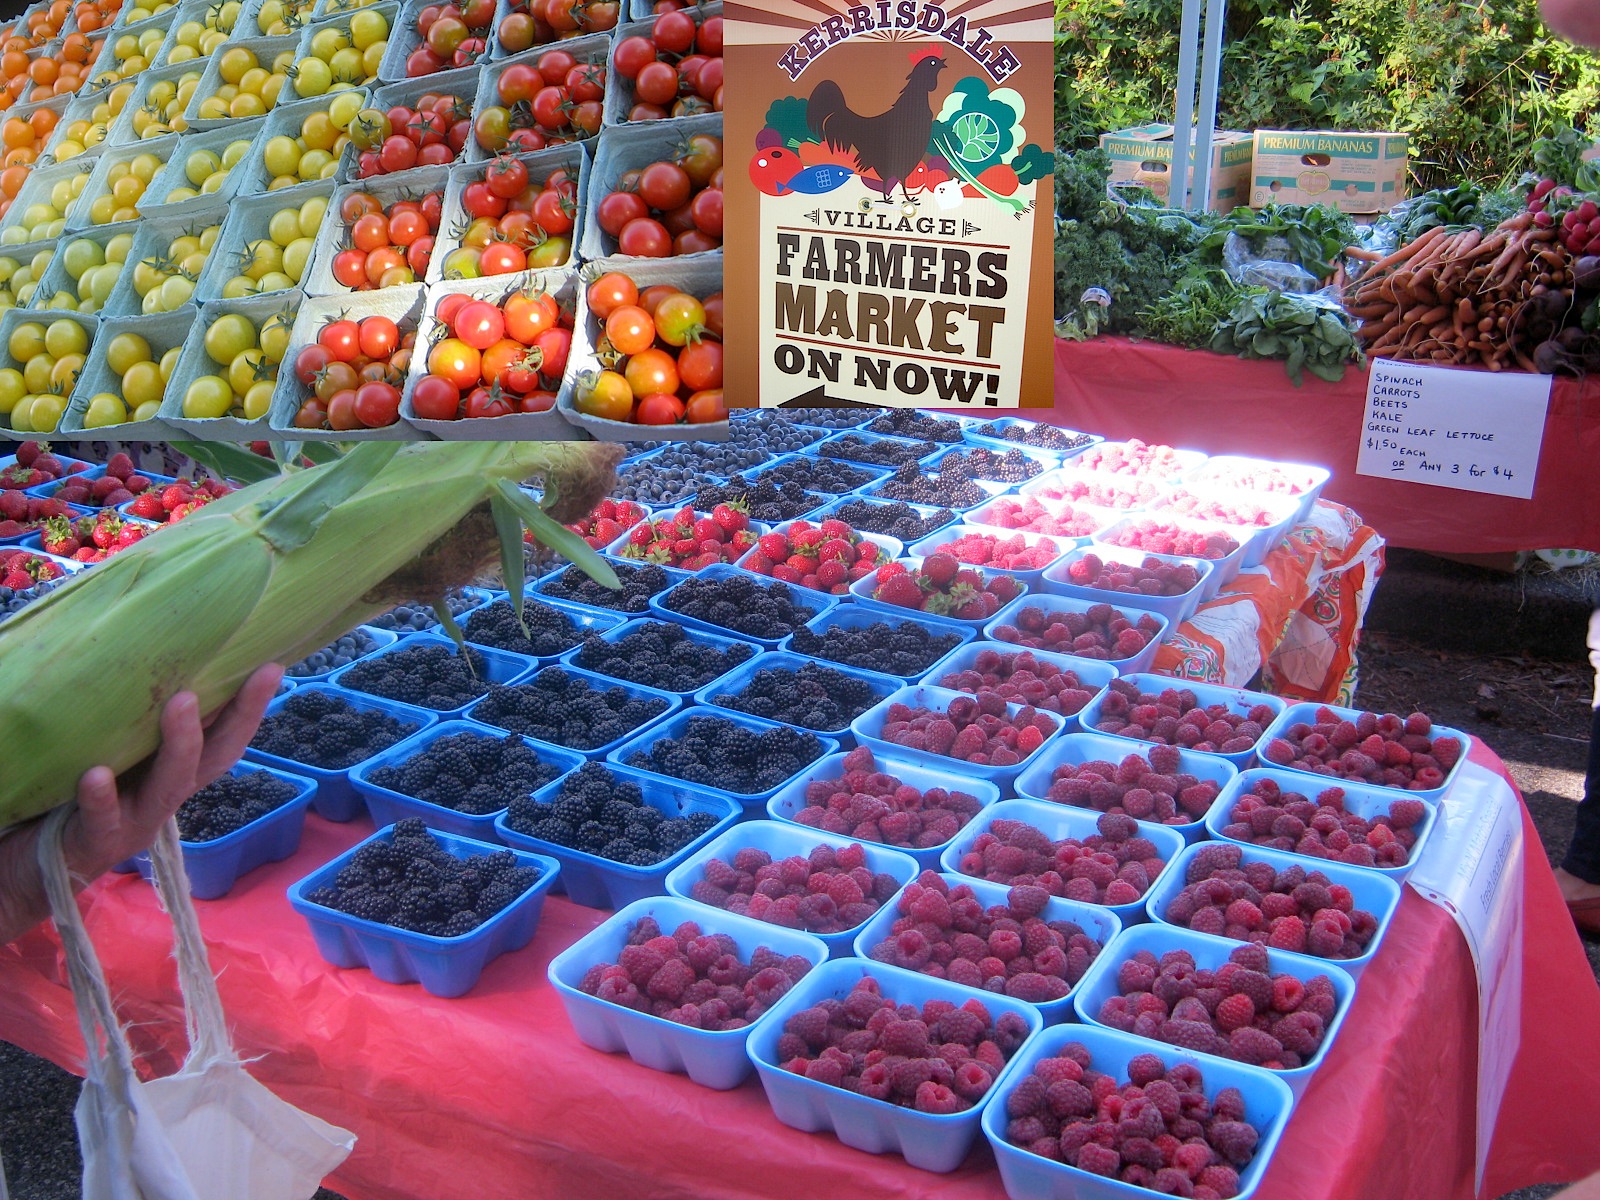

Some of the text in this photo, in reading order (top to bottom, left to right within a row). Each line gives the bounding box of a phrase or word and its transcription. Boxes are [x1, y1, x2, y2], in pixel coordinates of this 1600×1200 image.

[777, 0, 1022, 84] KERRISDALE
[1108, 143, 1155, 158] PREMIUM
[1263, 137, 1315, 150] PREMIUM
[1317, 140, 1373, 154] BANANAS
[824, 209, 957, 236] VILLAGE
[776, 233, 1008, 300] FARMERS
[775, 281, 1006, 359] MARKET
[774, 344, 1000, 407] ON NOW!
[1375, 373, 1423, 386] SPINACH
[1373, 385, 1420, 399] CARROTS
[1373, 397, 1408, 409] BEETS
[1372, 411, 1403, 422] KALE
[1367, 422, 1494, 441] GREEN LEAF LETTUCE
[1367, 437, 1426, 457] $1.50 EACH
[1450, 464, 1460, 474] 3
[1469, 464, 1486, 477] for
